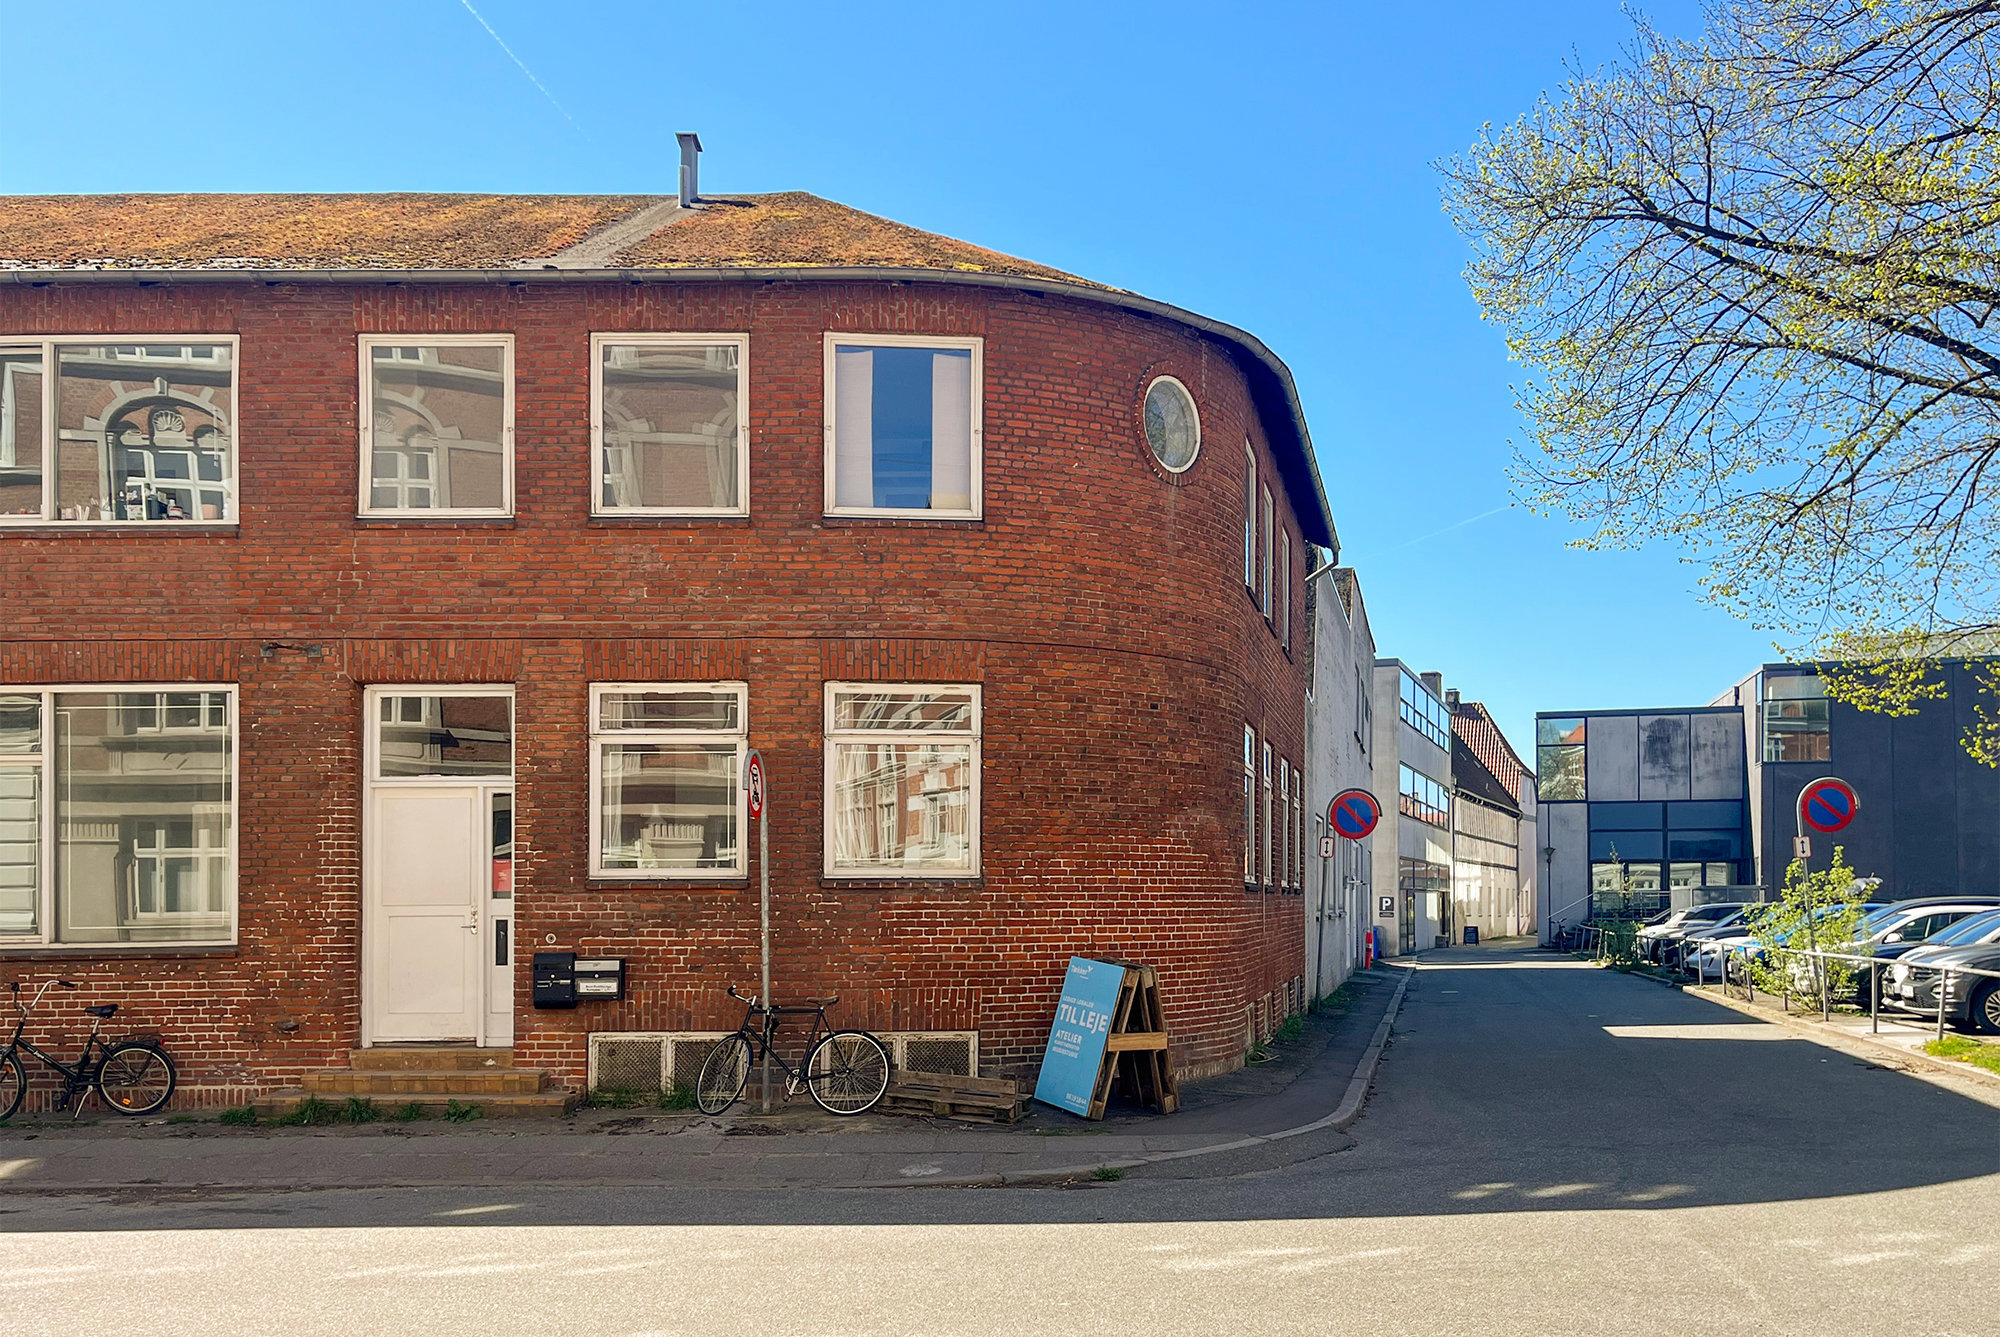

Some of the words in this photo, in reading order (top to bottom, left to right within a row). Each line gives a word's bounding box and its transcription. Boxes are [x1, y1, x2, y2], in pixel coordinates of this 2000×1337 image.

[1382, 898, 1392, 910] P
[1060, 1003, 1077, 1025] TIL
[1079, 1009, 1109, 1034] LEJE
[1055, 1029, 1083, 1045] ATELIER
